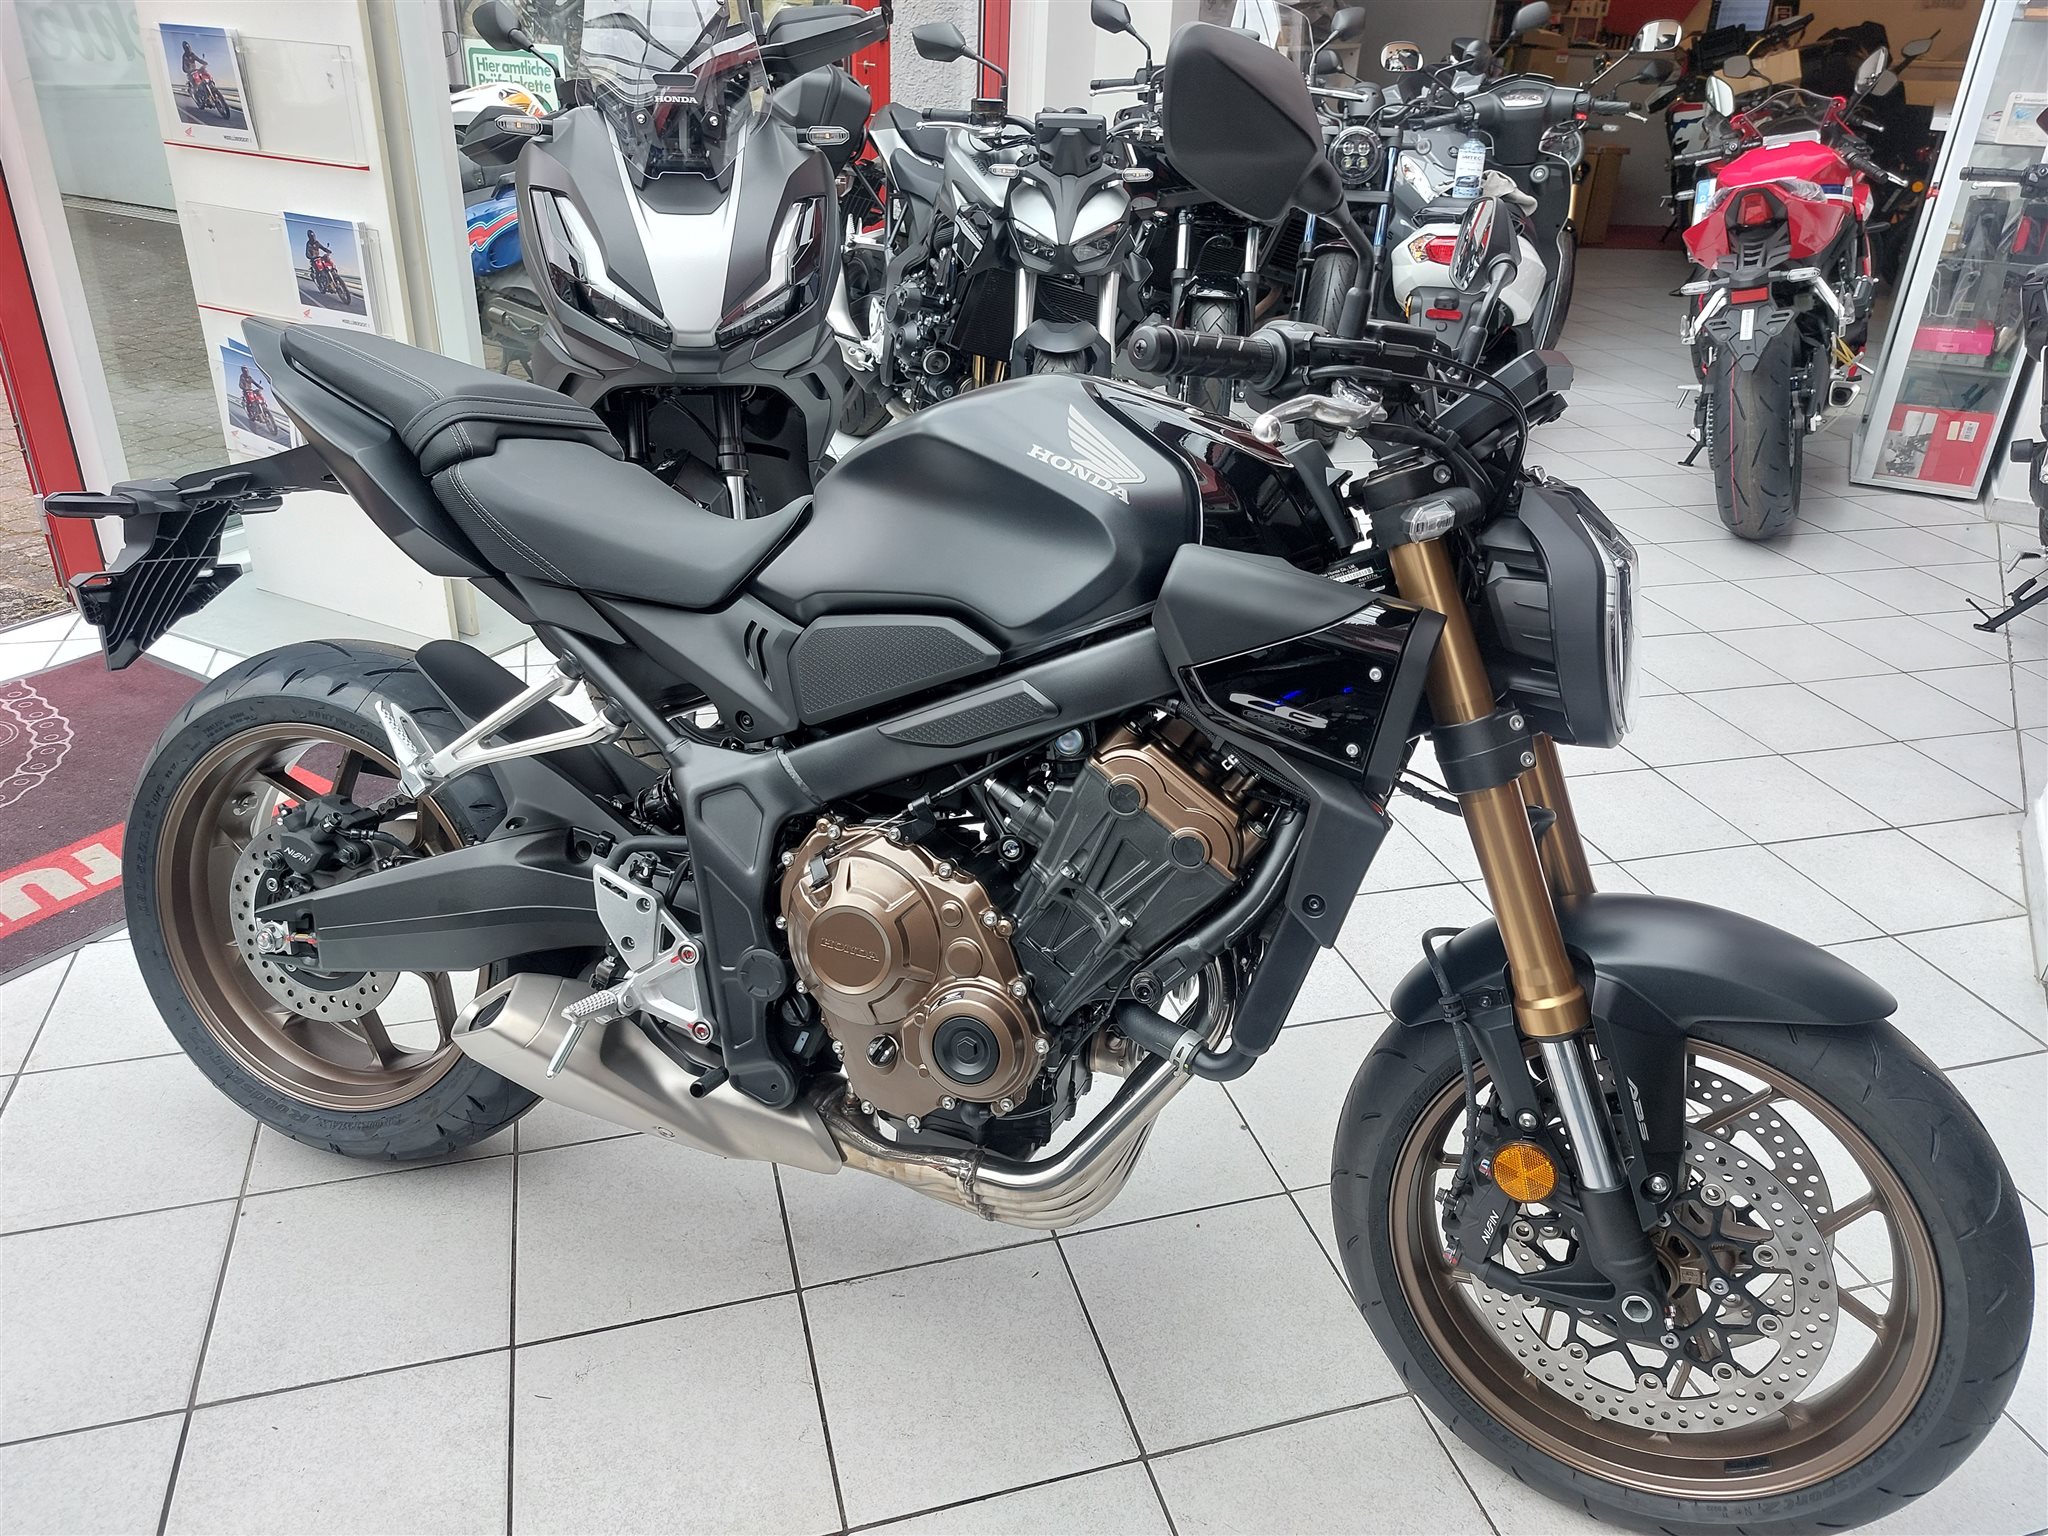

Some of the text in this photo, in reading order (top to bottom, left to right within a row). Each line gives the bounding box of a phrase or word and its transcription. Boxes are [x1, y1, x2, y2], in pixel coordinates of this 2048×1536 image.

[476, 56, 552, 77] Hier amtliche
[654, 95, 699, 104] HONDA
[1026, 443, 1130, 505] HONDA
[1229, 693, 1329, 729] CB
[283, 846, 311, 864] NISSIN
[819, 936, 880, 963] HONDA
[1626, 1075, 1650, 1142] ABS
[1481, 1209, 1500, 1245] NISSIN
